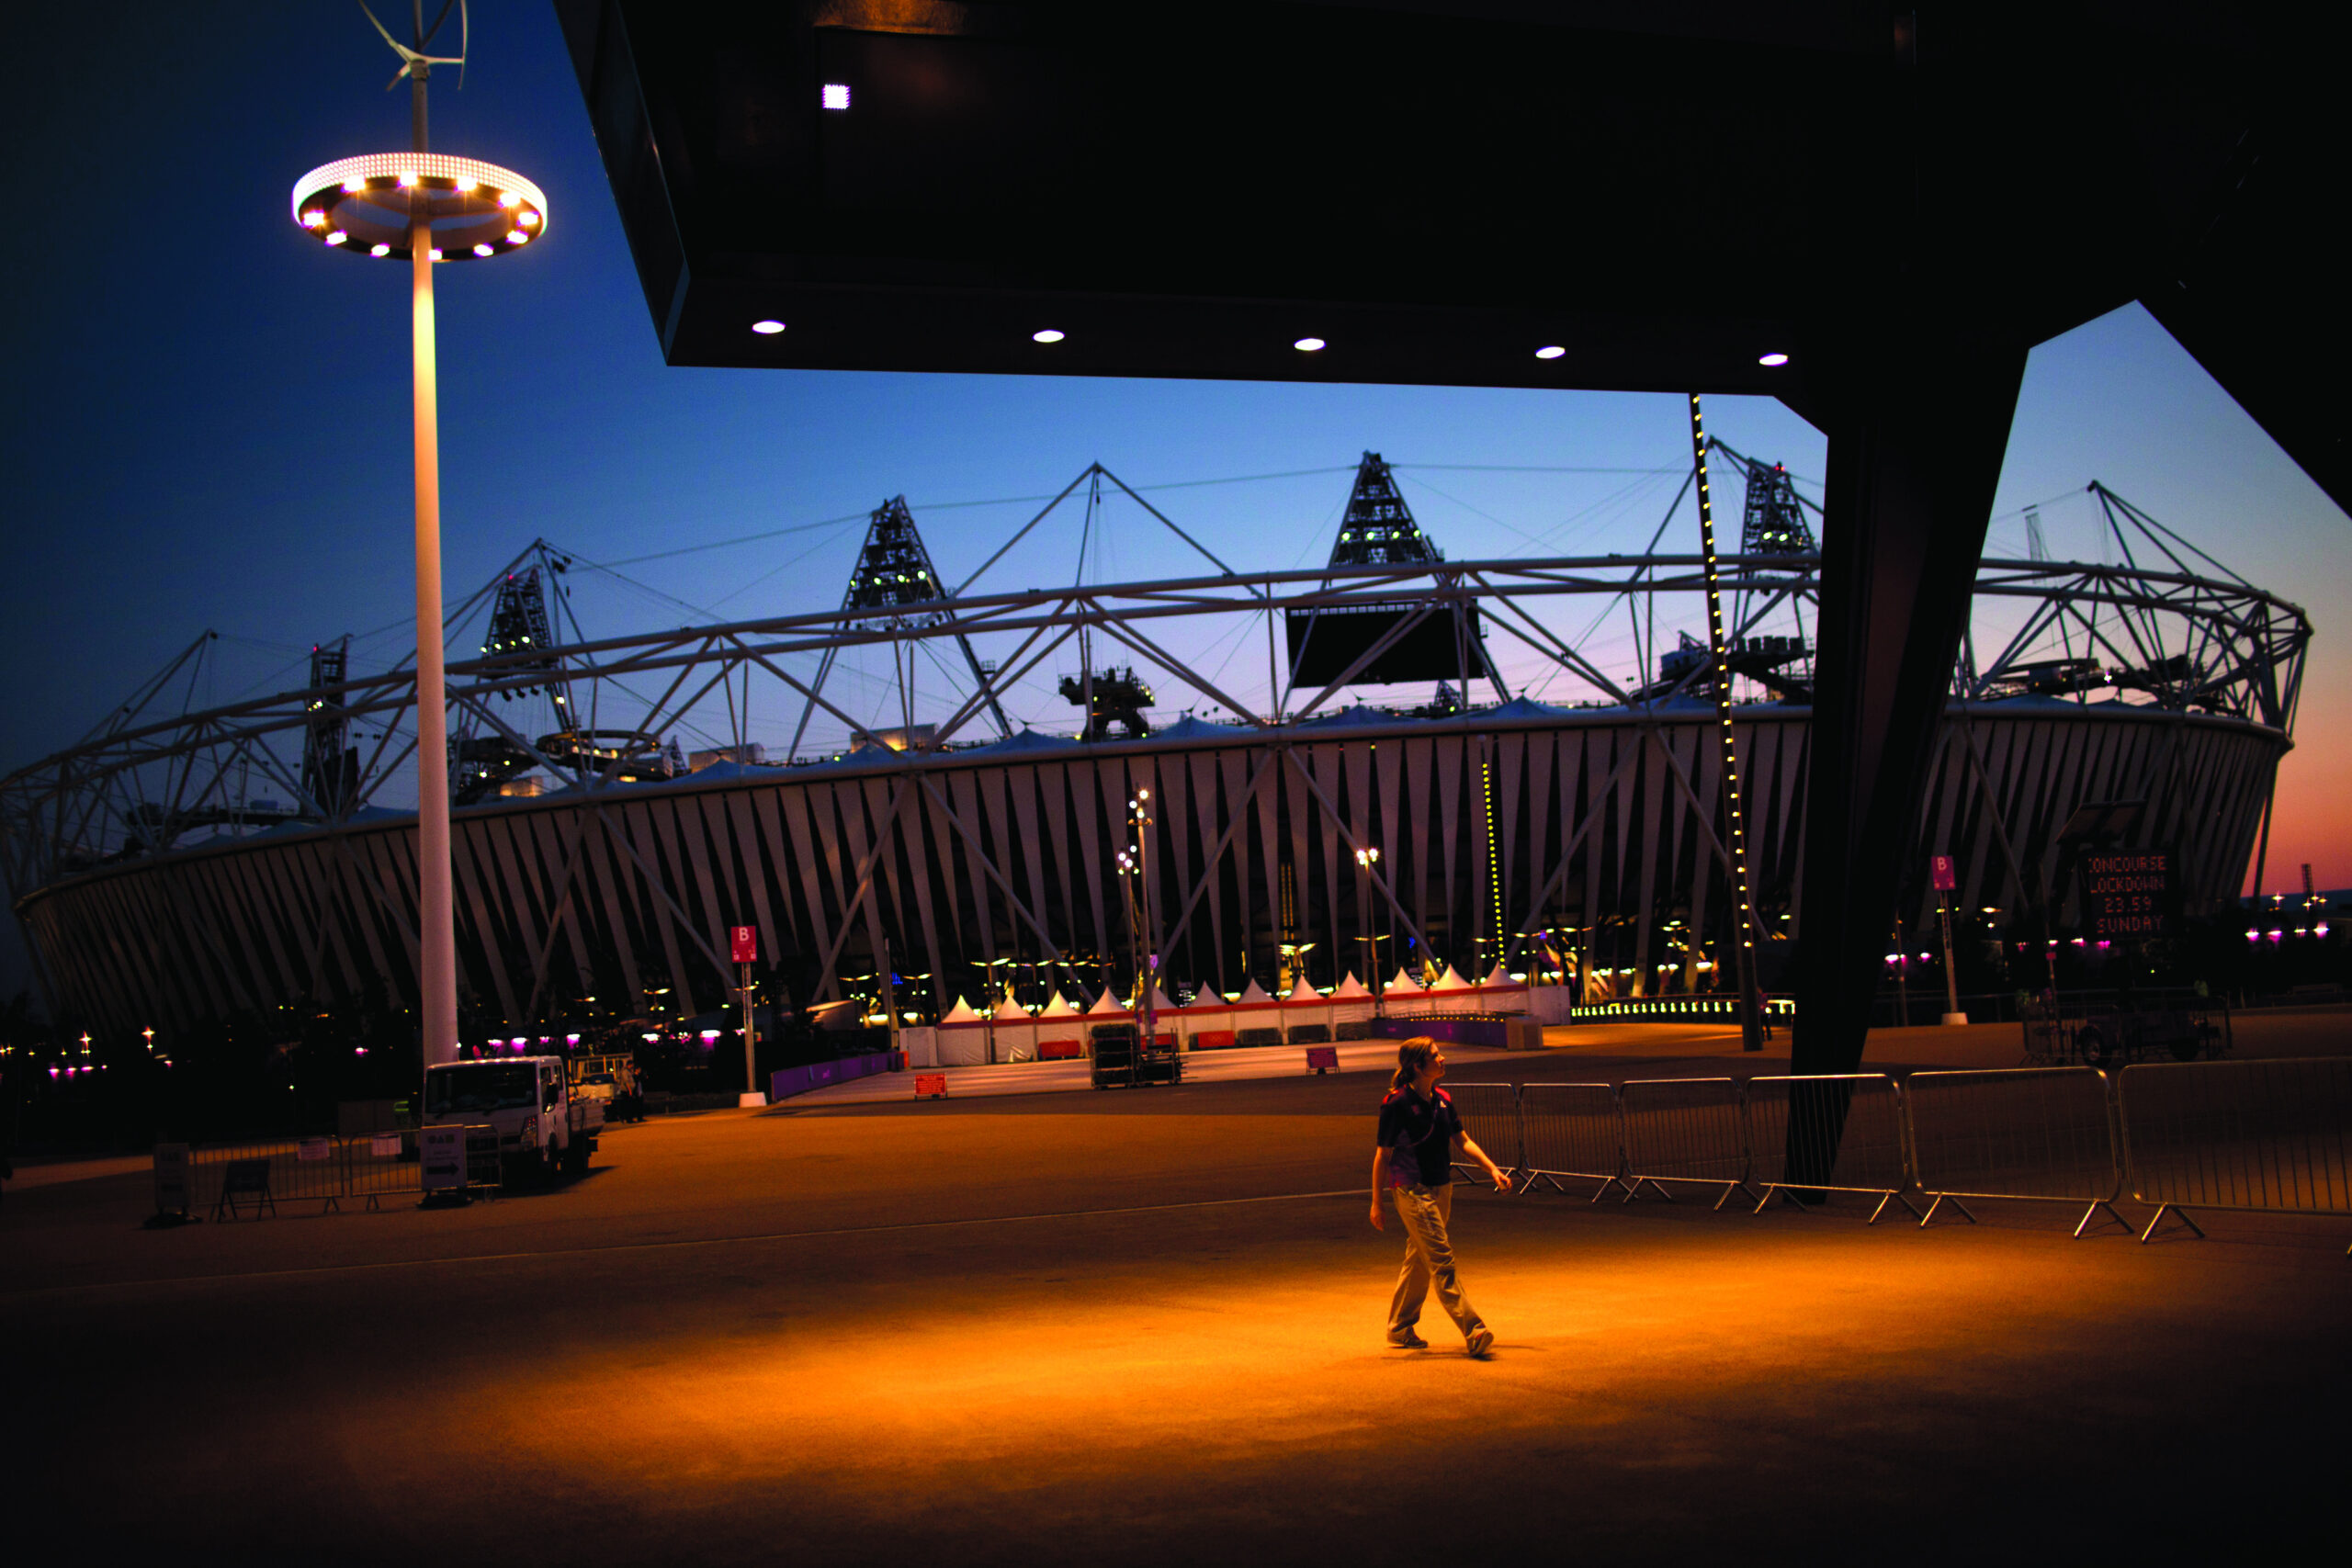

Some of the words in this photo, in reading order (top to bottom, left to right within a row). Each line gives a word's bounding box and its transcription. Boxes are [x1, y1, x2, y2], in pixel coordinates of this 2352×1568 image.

[1937, 856, 1947, 871] B
[2089, 875, 2165, 894] LOCKDOWN
[2096, 915, 2164, 933] SUNDAY
[739, 927, 750, 942] B
